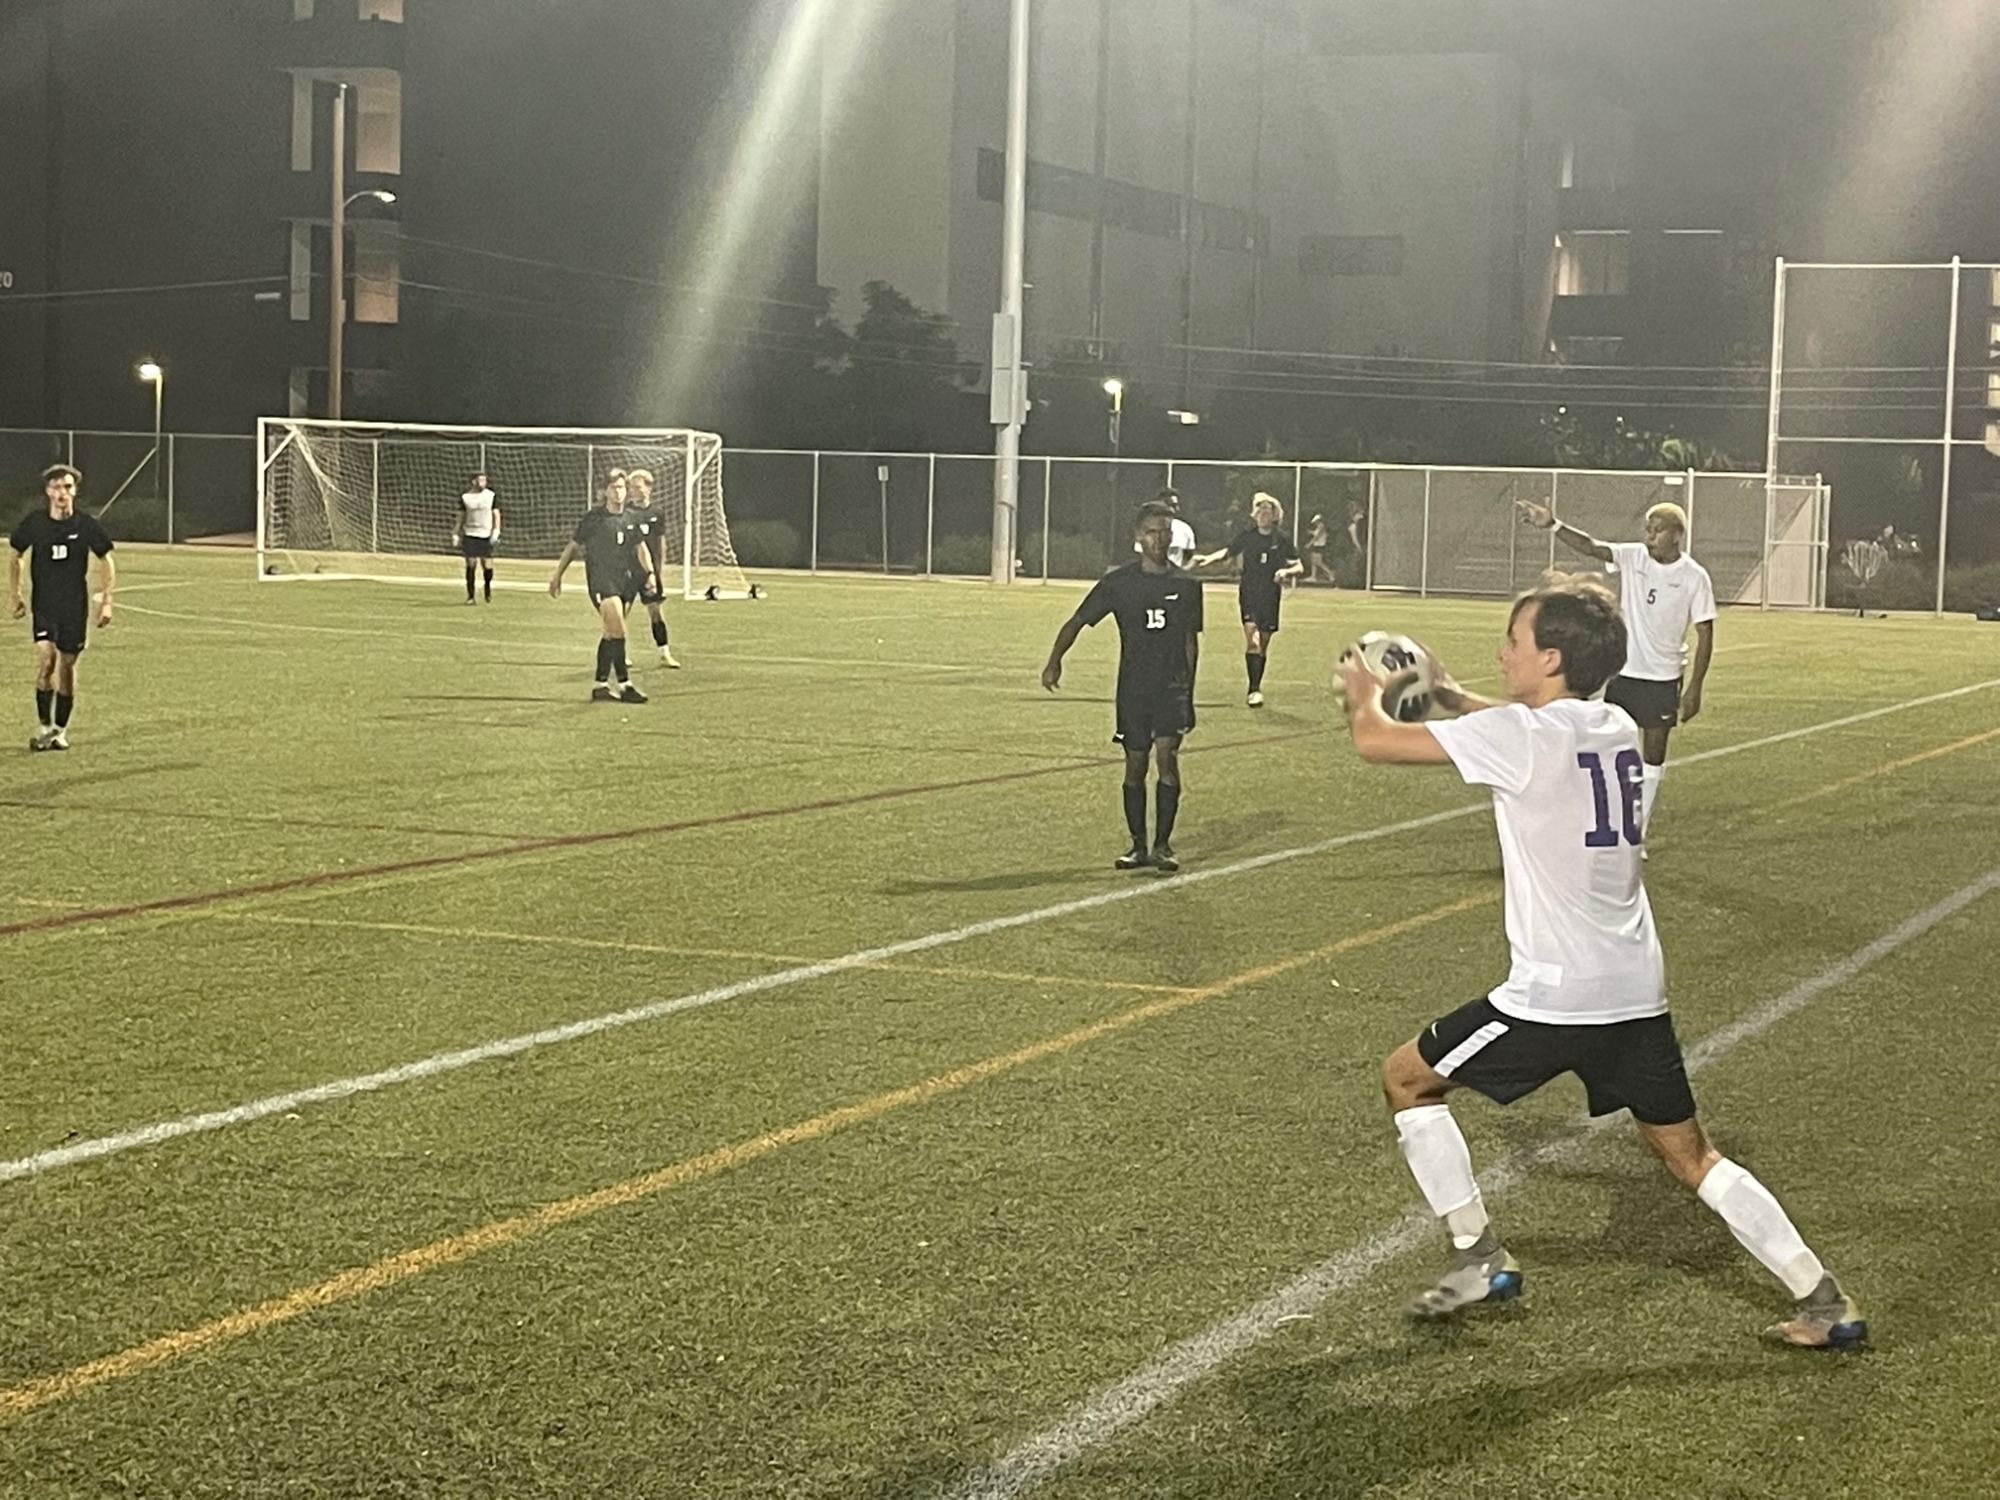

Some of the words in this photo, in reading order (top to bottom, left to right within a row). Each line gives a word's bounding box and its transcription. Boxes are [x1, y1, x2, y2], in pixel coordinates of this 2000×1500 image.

[1646, 588, 1658, 605] 5
[1146, 609, 1166, 629] 15
[1577, 748, 1644, 847] 16
